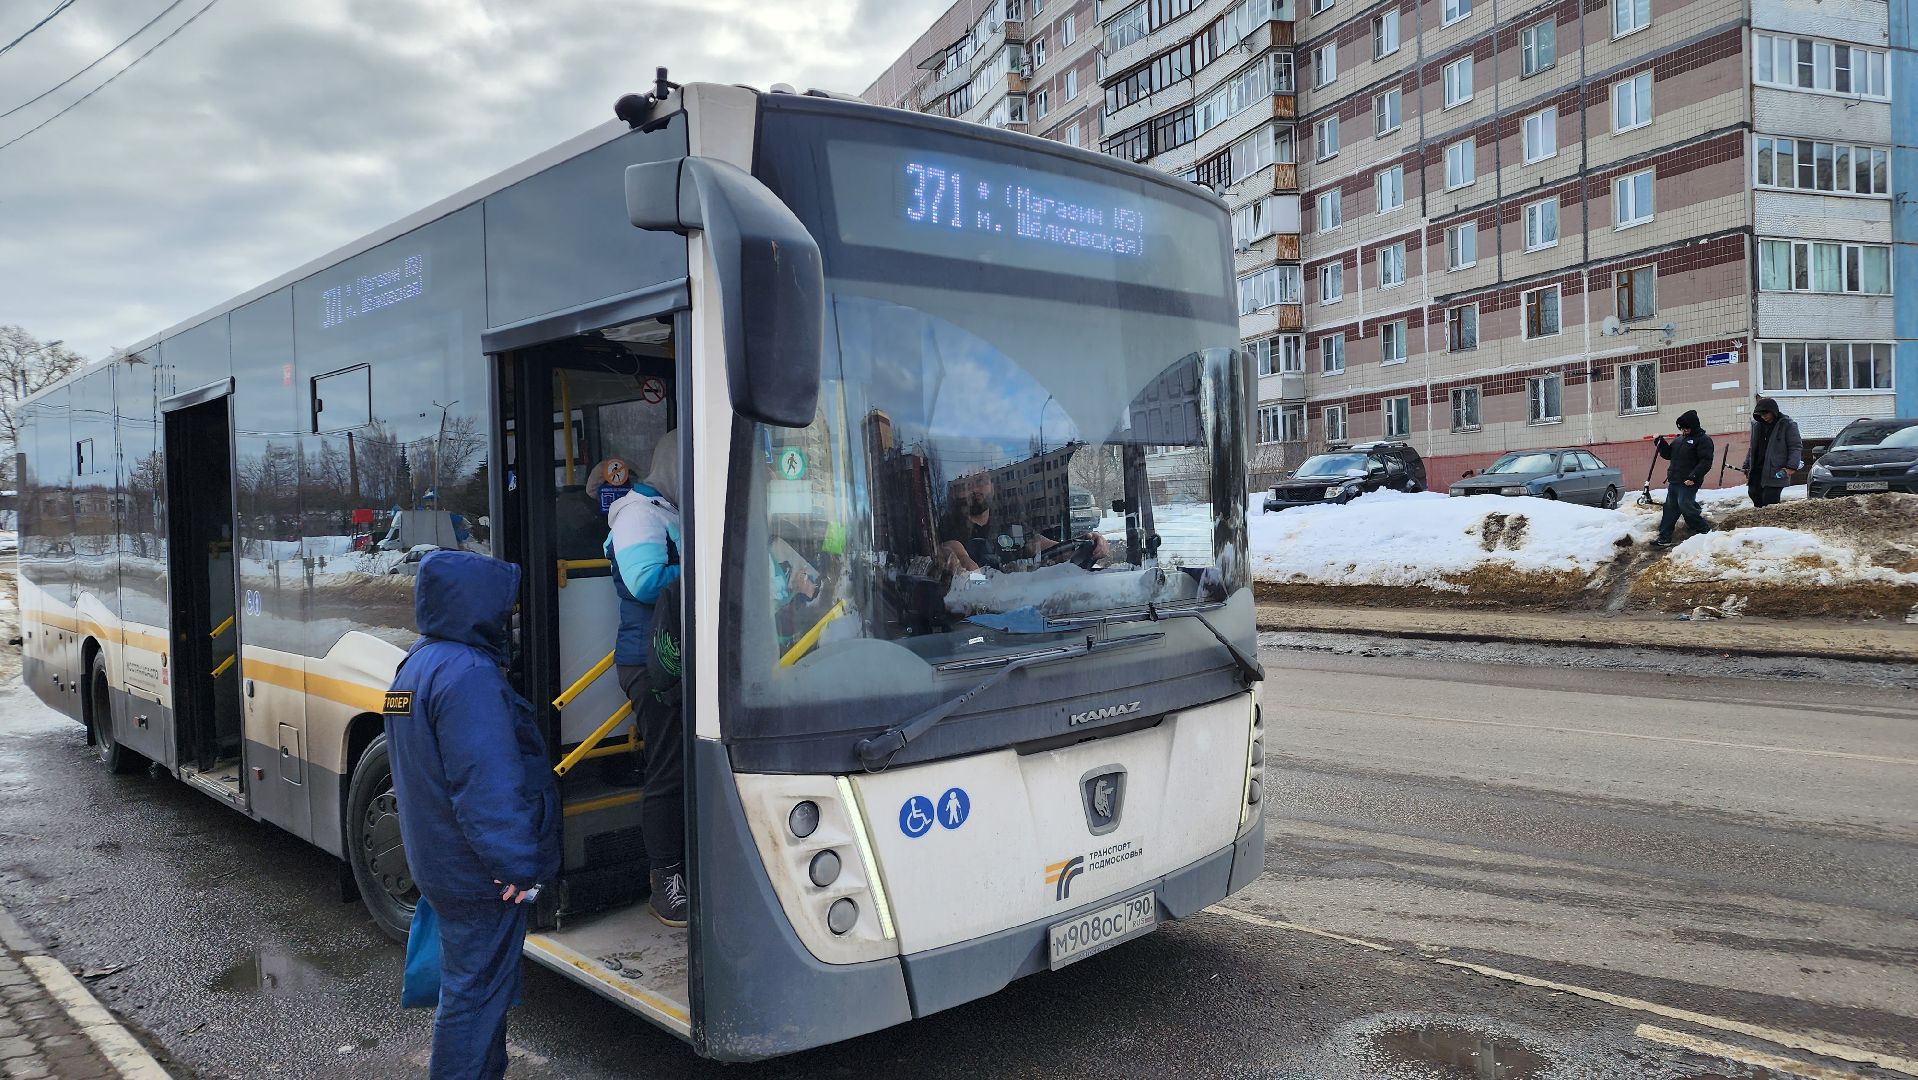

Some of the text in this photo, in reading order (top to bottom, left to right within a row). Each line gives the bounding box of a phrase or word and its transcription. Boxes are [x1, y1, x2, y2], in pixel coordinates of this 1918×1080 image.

[906, 163, 962, 228] 371
[1069, 701, 1141, 726] KAMAZ
[1089, 841, 1132, 860] ТРАНСПОРТ
[1089, 848, 1143, 872] ПОДМОСКОВЬЯ
[1126, 896, 1151, 921] 790
[1132, 917, 1145, 928] RUS
